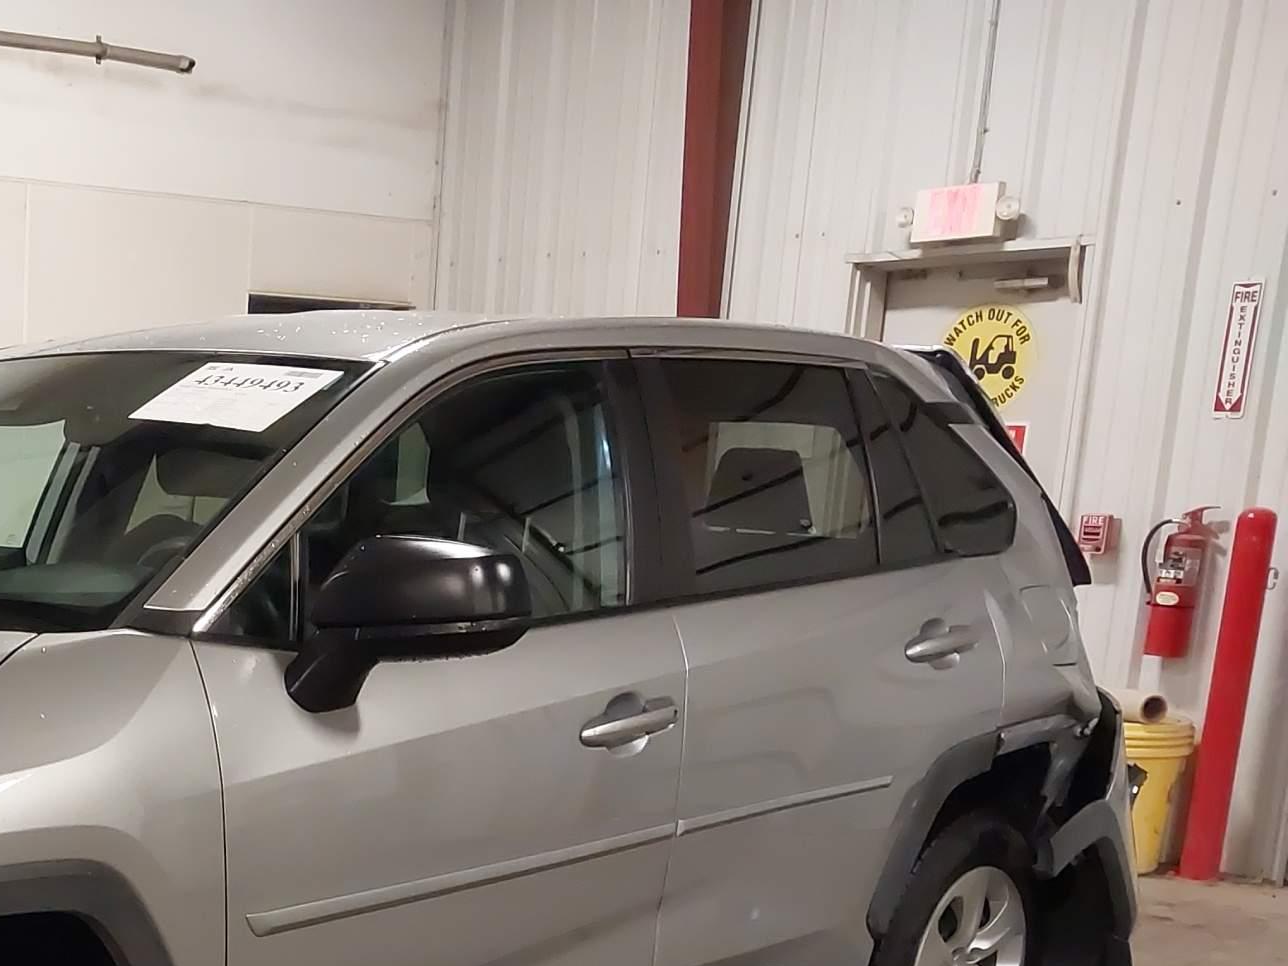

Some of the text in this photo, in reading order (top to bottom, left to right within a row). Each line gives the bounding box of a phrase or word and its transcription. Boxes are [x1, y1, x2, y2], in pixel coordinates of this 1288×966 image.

[1234, 291, 1258, 302] FIRE
[944, 308, 1031, 347] WATCH OUT FOR
[1224, 305, 1247, 405] EXTINGUISHER
[195, 374, 305, 393] 43449493
[991, 375, 1025, 407] RUCKS
[1083, 515, 1105, 525] FIRE
